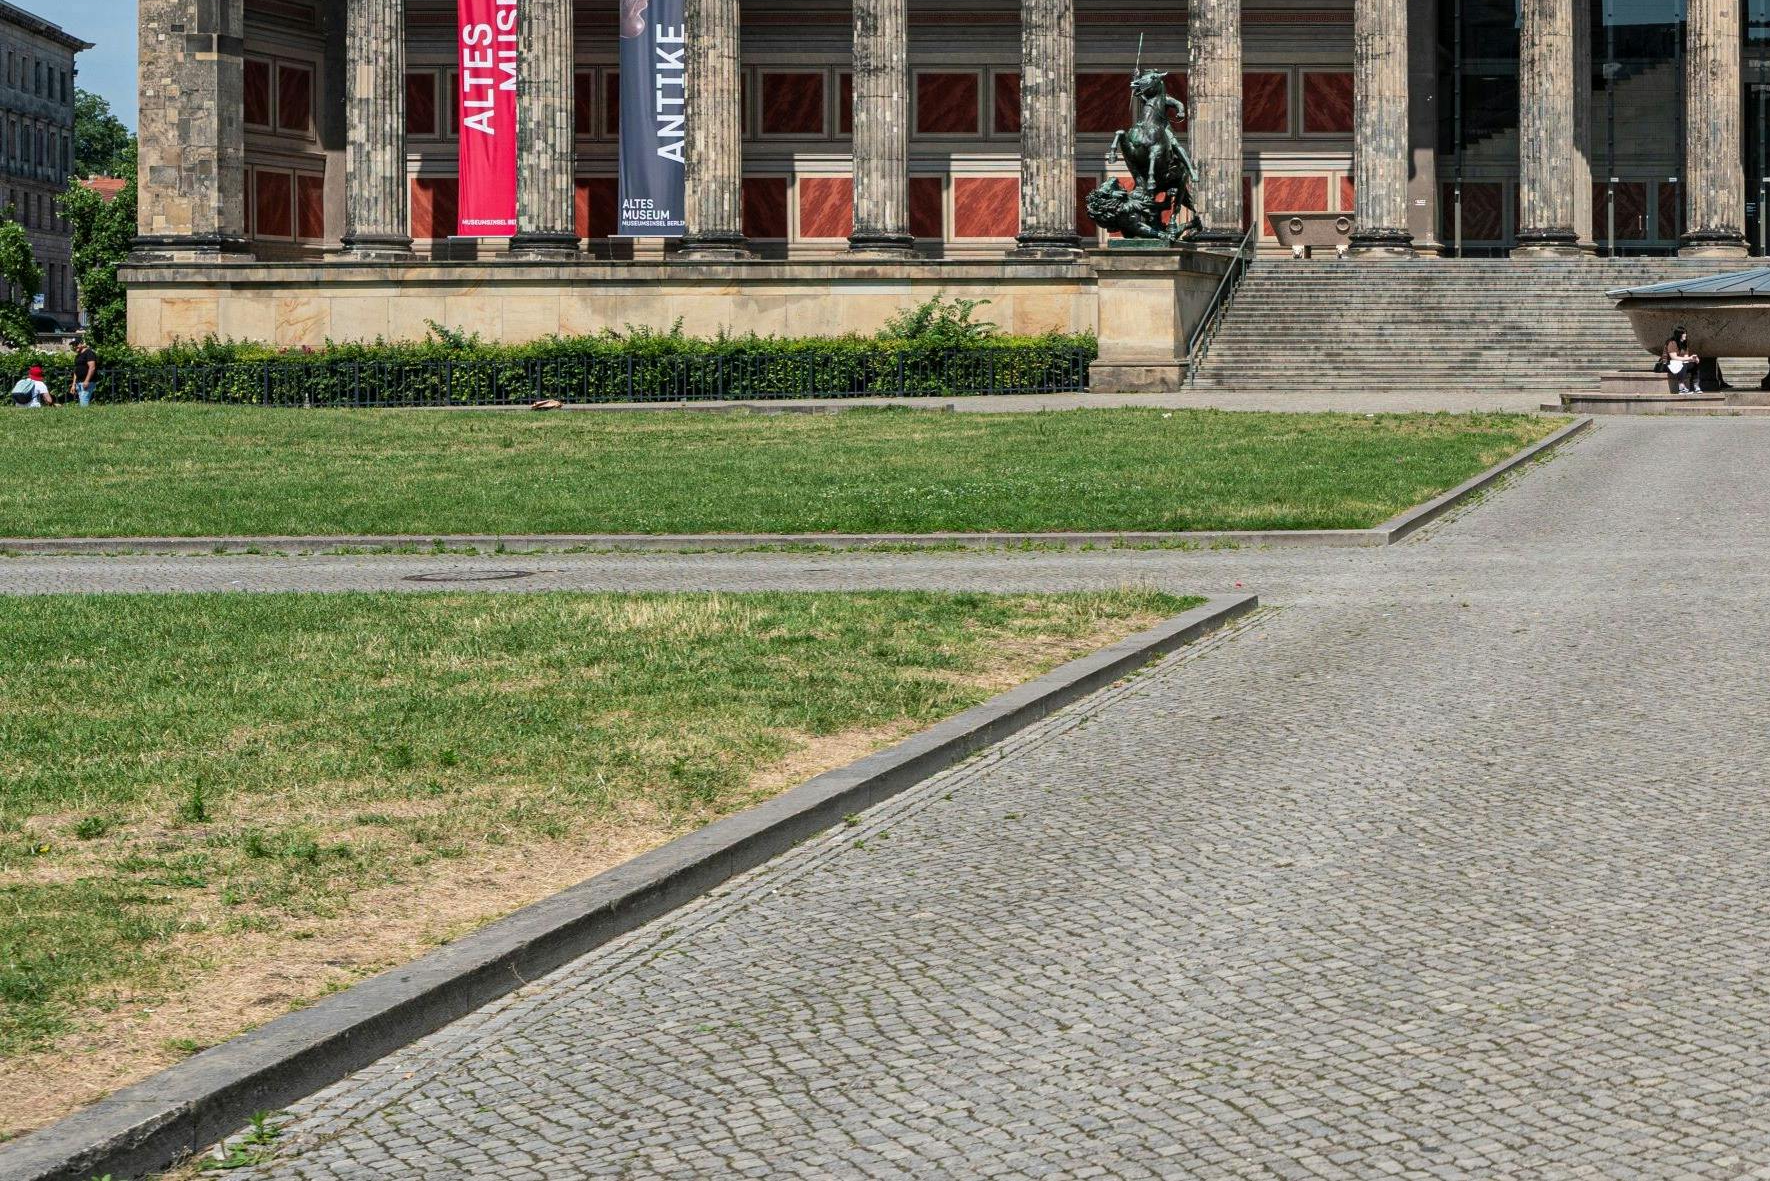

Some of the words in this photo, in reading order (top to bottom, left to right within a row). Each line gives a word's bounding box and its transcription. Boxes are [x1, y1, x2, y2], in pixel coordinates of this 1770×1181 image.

[462, 23, 495, 135] ALTES
[656, 23, 686, 164] ANTIKE
[622, 198, 654, 209] ALTES
[622, 209, 670, 220] MUSEUM
